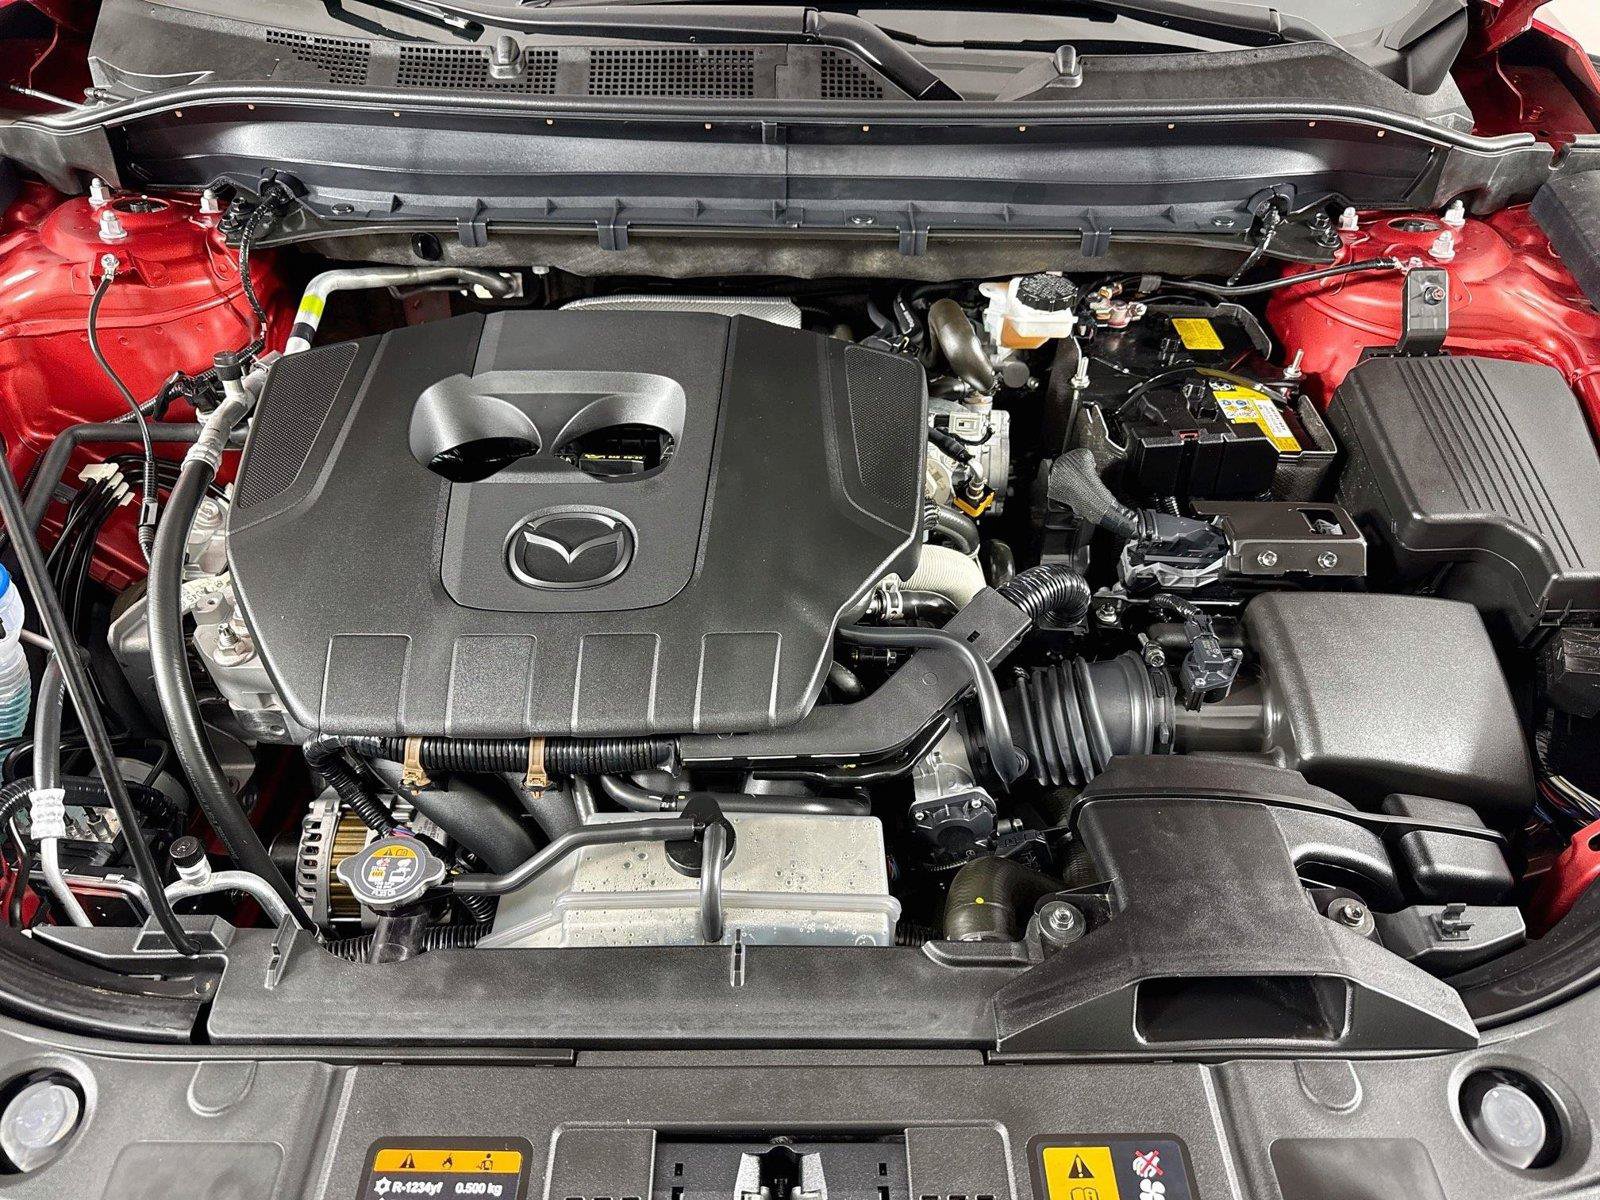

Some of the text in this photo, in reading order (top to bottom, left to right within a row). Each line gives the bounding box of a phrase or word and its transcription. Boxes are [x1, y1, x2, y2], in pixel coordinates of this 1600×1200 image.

[391, 1181, 503, 1197] R-1234yf 0.500 kg
